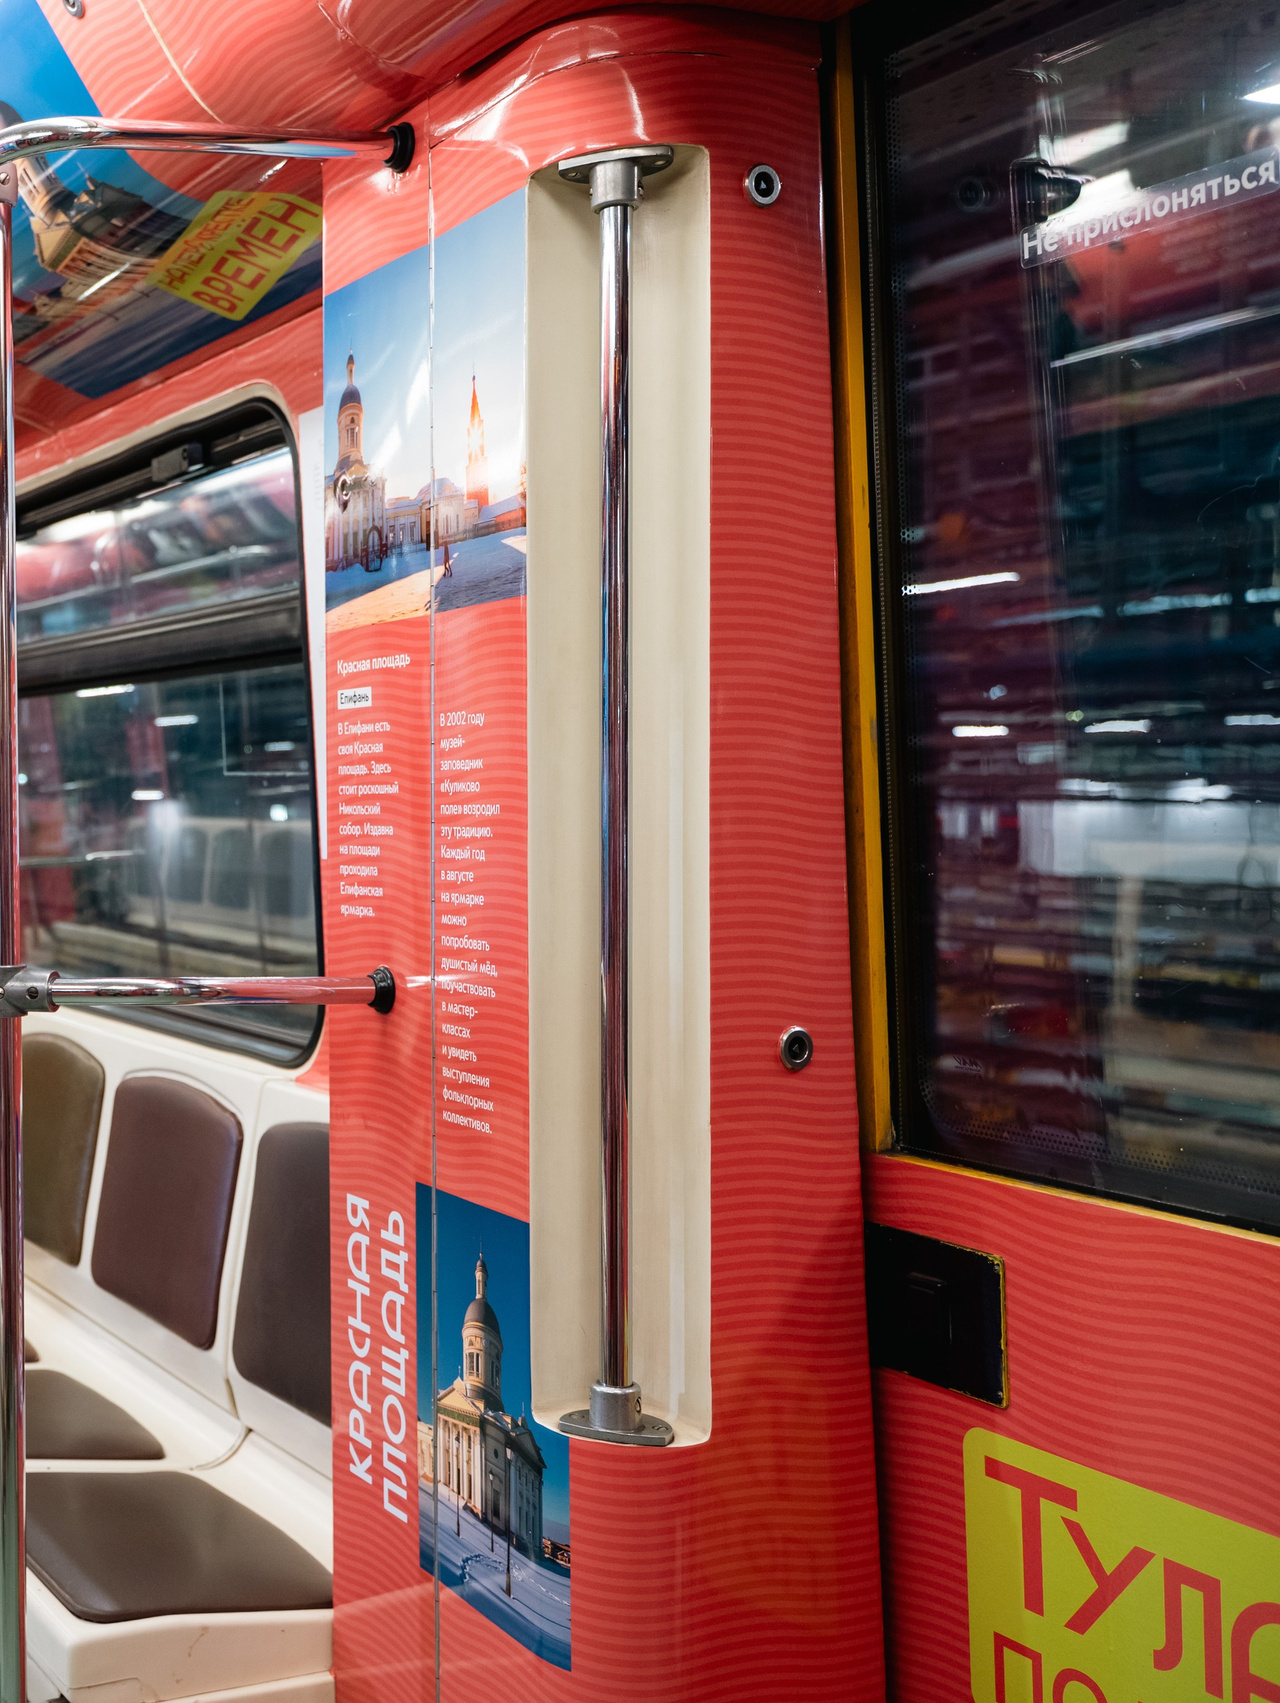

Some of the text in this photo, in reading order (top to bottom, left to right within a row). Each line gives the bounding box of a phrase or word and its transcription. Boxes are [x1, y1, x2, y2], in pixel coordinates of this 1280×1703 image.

[1023, 160, 1276, 260] Не прислоняться
[337, 653, 411, 677] Красная площадь
[340, 691, 370, 706] Епифань
[440, 711, 485, 727] В 2002 году
[338, 720, 390, 736] В Епифани есть
[338, 741, 383, 756] своя Красная
[440, 735, 465, 751] музей-
[338, 760, 391, 775] площадь. Здесь
[440, 759, 483, 771] заповедник
[339, 781, 399, 797] стоит роскошный
[440, 779, 480, 796] «Куликово
[339, 802, 381, 815] Никольский
[440, 804, 500, 817] поле» возродил
[339, 822, 393, 837] собор. Издавна
[441, 826, 493, 839] эту традицию.
[340, 845, 380, 857] на площади
[441, 845, 485, 862] Каждый год
[340, 865, 378, 877] проходила
[441, 870, 474, 884] в августе
[340, 882, 383, 898] Епифанская
[441, 892, 484, 907] на ярмарке
[340, 905, 375, 918] ярмарка.
[441, 915, 467, 926] можно
[441, 935, 490, 951] попробовать
[441, 957, 498, 978] душистый мёд,
[441, 980, 496, 998] поучаствовать
[442, 1001, 478, 1019] в мастер-
[442, 1023, 471, 1039] классах
[442, 1045, 477, 1062] и увидеть
[442, 1066, 490, 1088] выступления
[443, 1084, 494, 1112] фольклорных
[443, 1110, 492, 1134] коллективов.
[346, 1193, 373, 1485] КРАСНАЯ
[381, 1210, 409, 1523] ПЛОЩАДЬ
